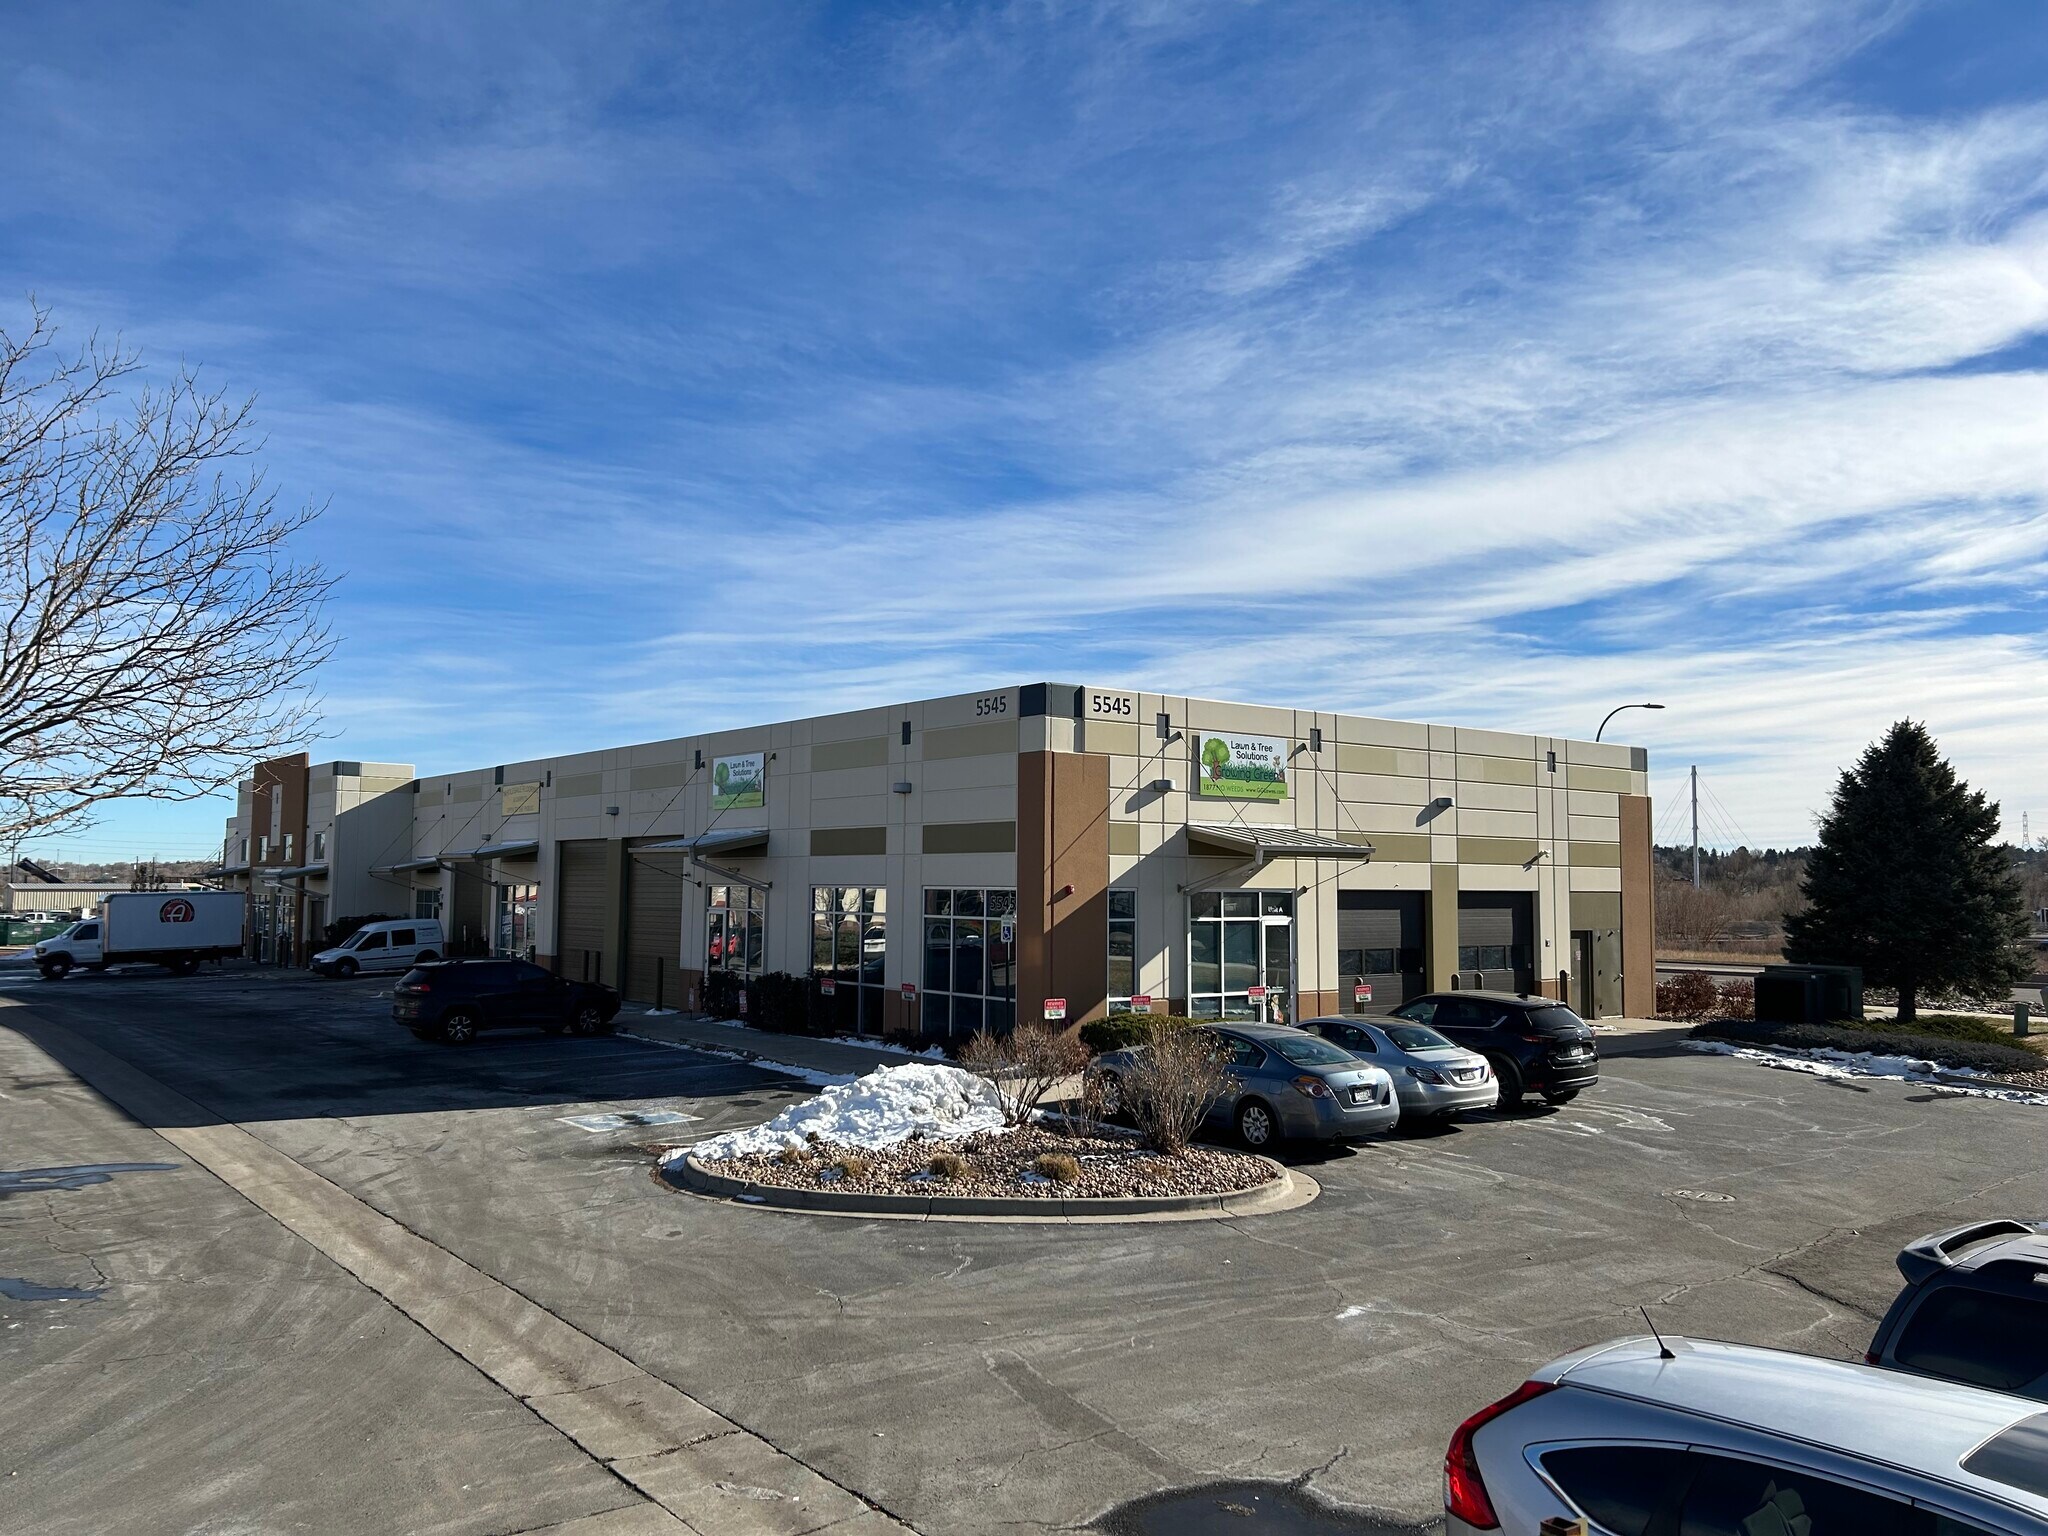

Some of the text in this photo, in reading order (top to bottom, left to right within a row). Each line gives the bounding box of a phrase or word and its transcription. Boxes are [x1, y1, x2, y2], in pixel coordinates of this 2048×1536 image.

[976, 695, 1007, 717] 5545
[1092, 695, 1132, 716] 5545
[1230, 740, 1273, 752] Lawn & Tree
[1235, 750, 1269, 762] Solutions
[1215, 765, 1279, 783] Growing Green
